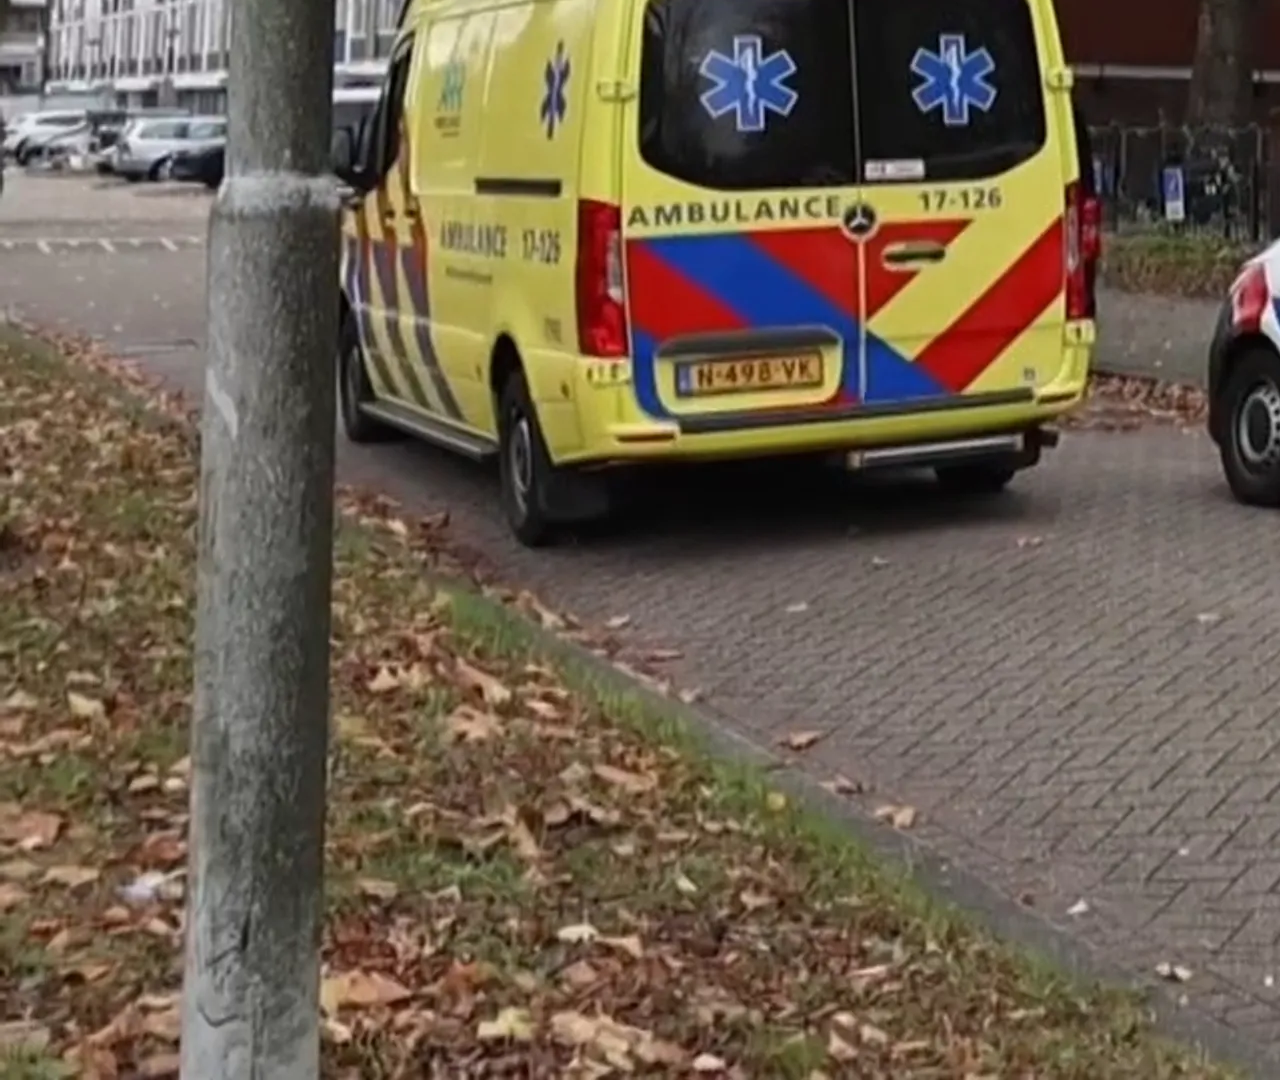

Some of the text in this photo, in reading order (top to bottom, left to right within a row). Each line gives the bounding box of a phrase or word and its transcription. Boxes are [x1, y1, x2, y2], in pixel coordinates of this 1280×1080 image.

[627, 187, 1002, 227] AMBULANCE 17-126
[441, 221, 506, 258] AMBULANCE
